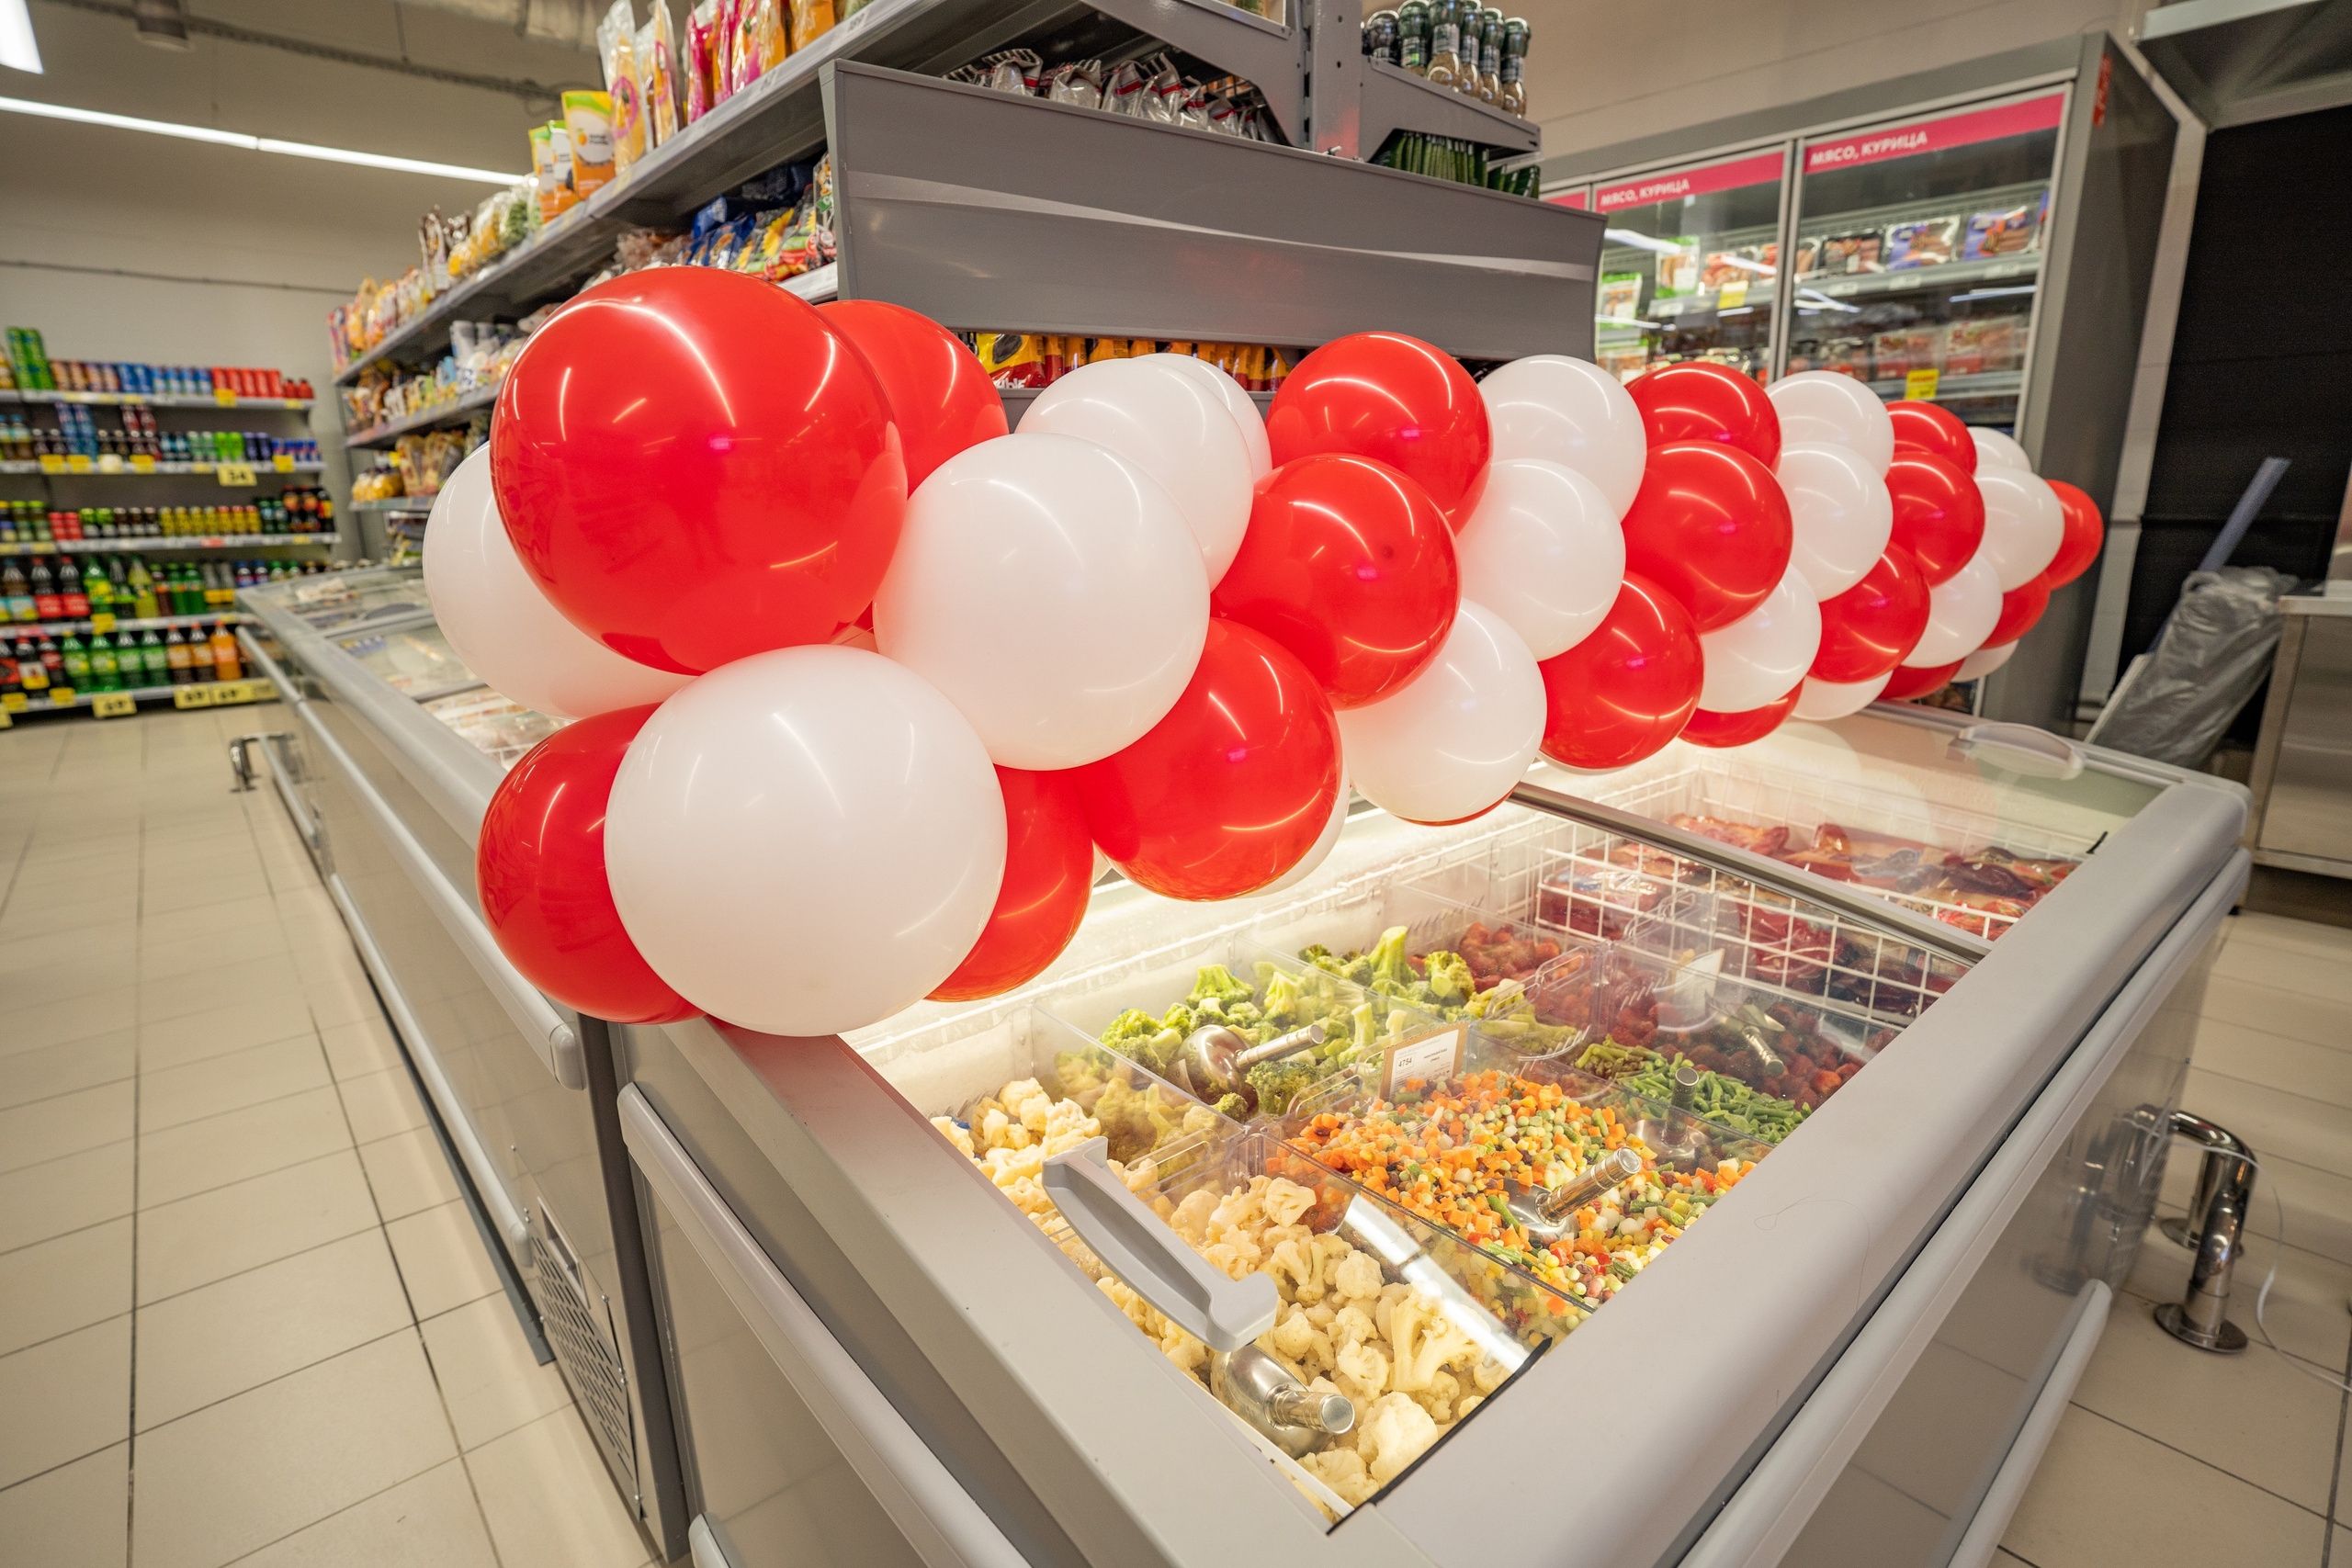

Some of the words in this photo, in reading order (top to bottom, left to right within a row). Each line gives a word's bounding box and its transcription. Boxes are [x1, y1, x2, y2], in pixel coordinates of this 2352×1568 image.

[1810, 144, 1860, 166] МЯСО,
[1861, 130, 1928, 157] КУРИЦА
[1600, 188, 1638, 207] МЯСО,
[1639, 178, 1690, 199] КУРИЦА
